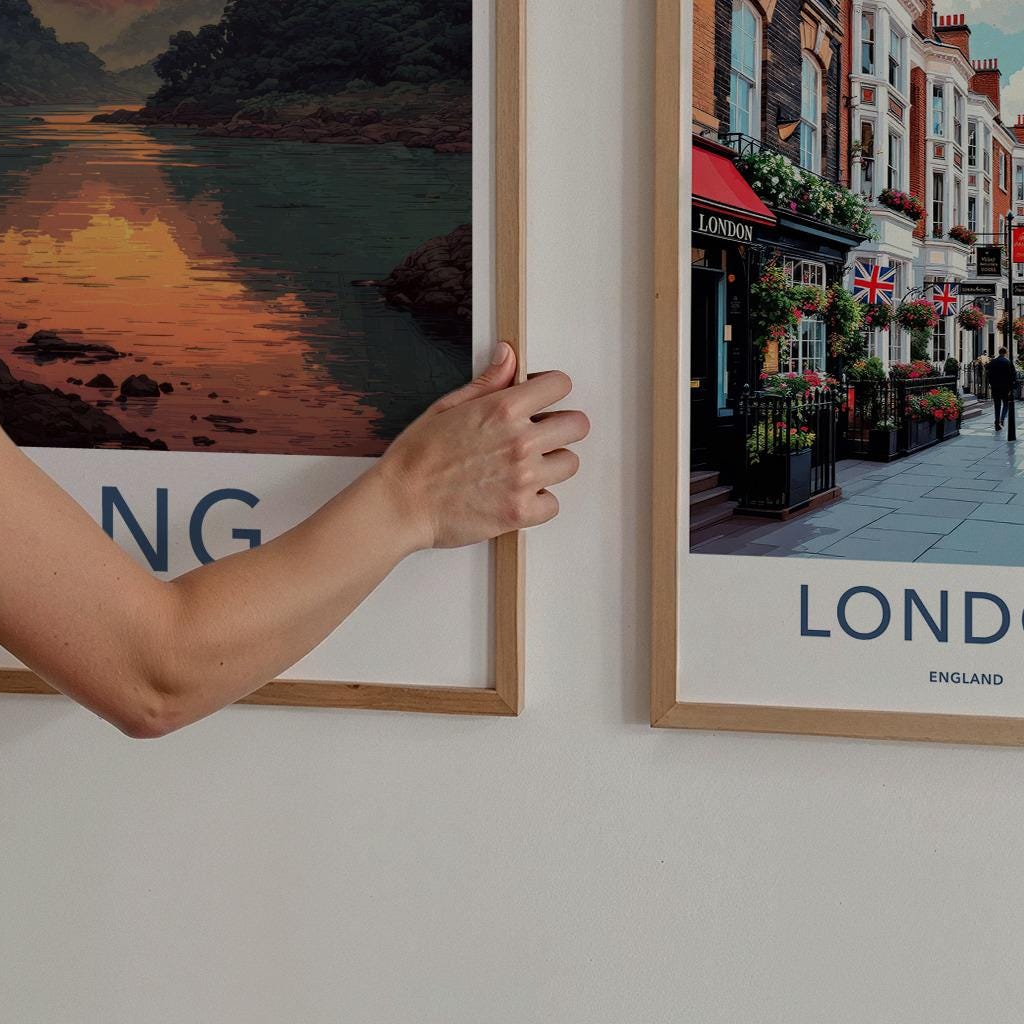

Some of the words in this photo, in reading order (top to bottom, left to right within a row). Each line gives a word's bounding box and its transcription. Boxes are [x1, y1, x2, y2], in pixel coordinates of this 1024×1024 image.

[698, 213, 753, 241] LONDON
[800, 583, 1024, 644] LOND
[928, 670, 1004, 686] ENGLAND
